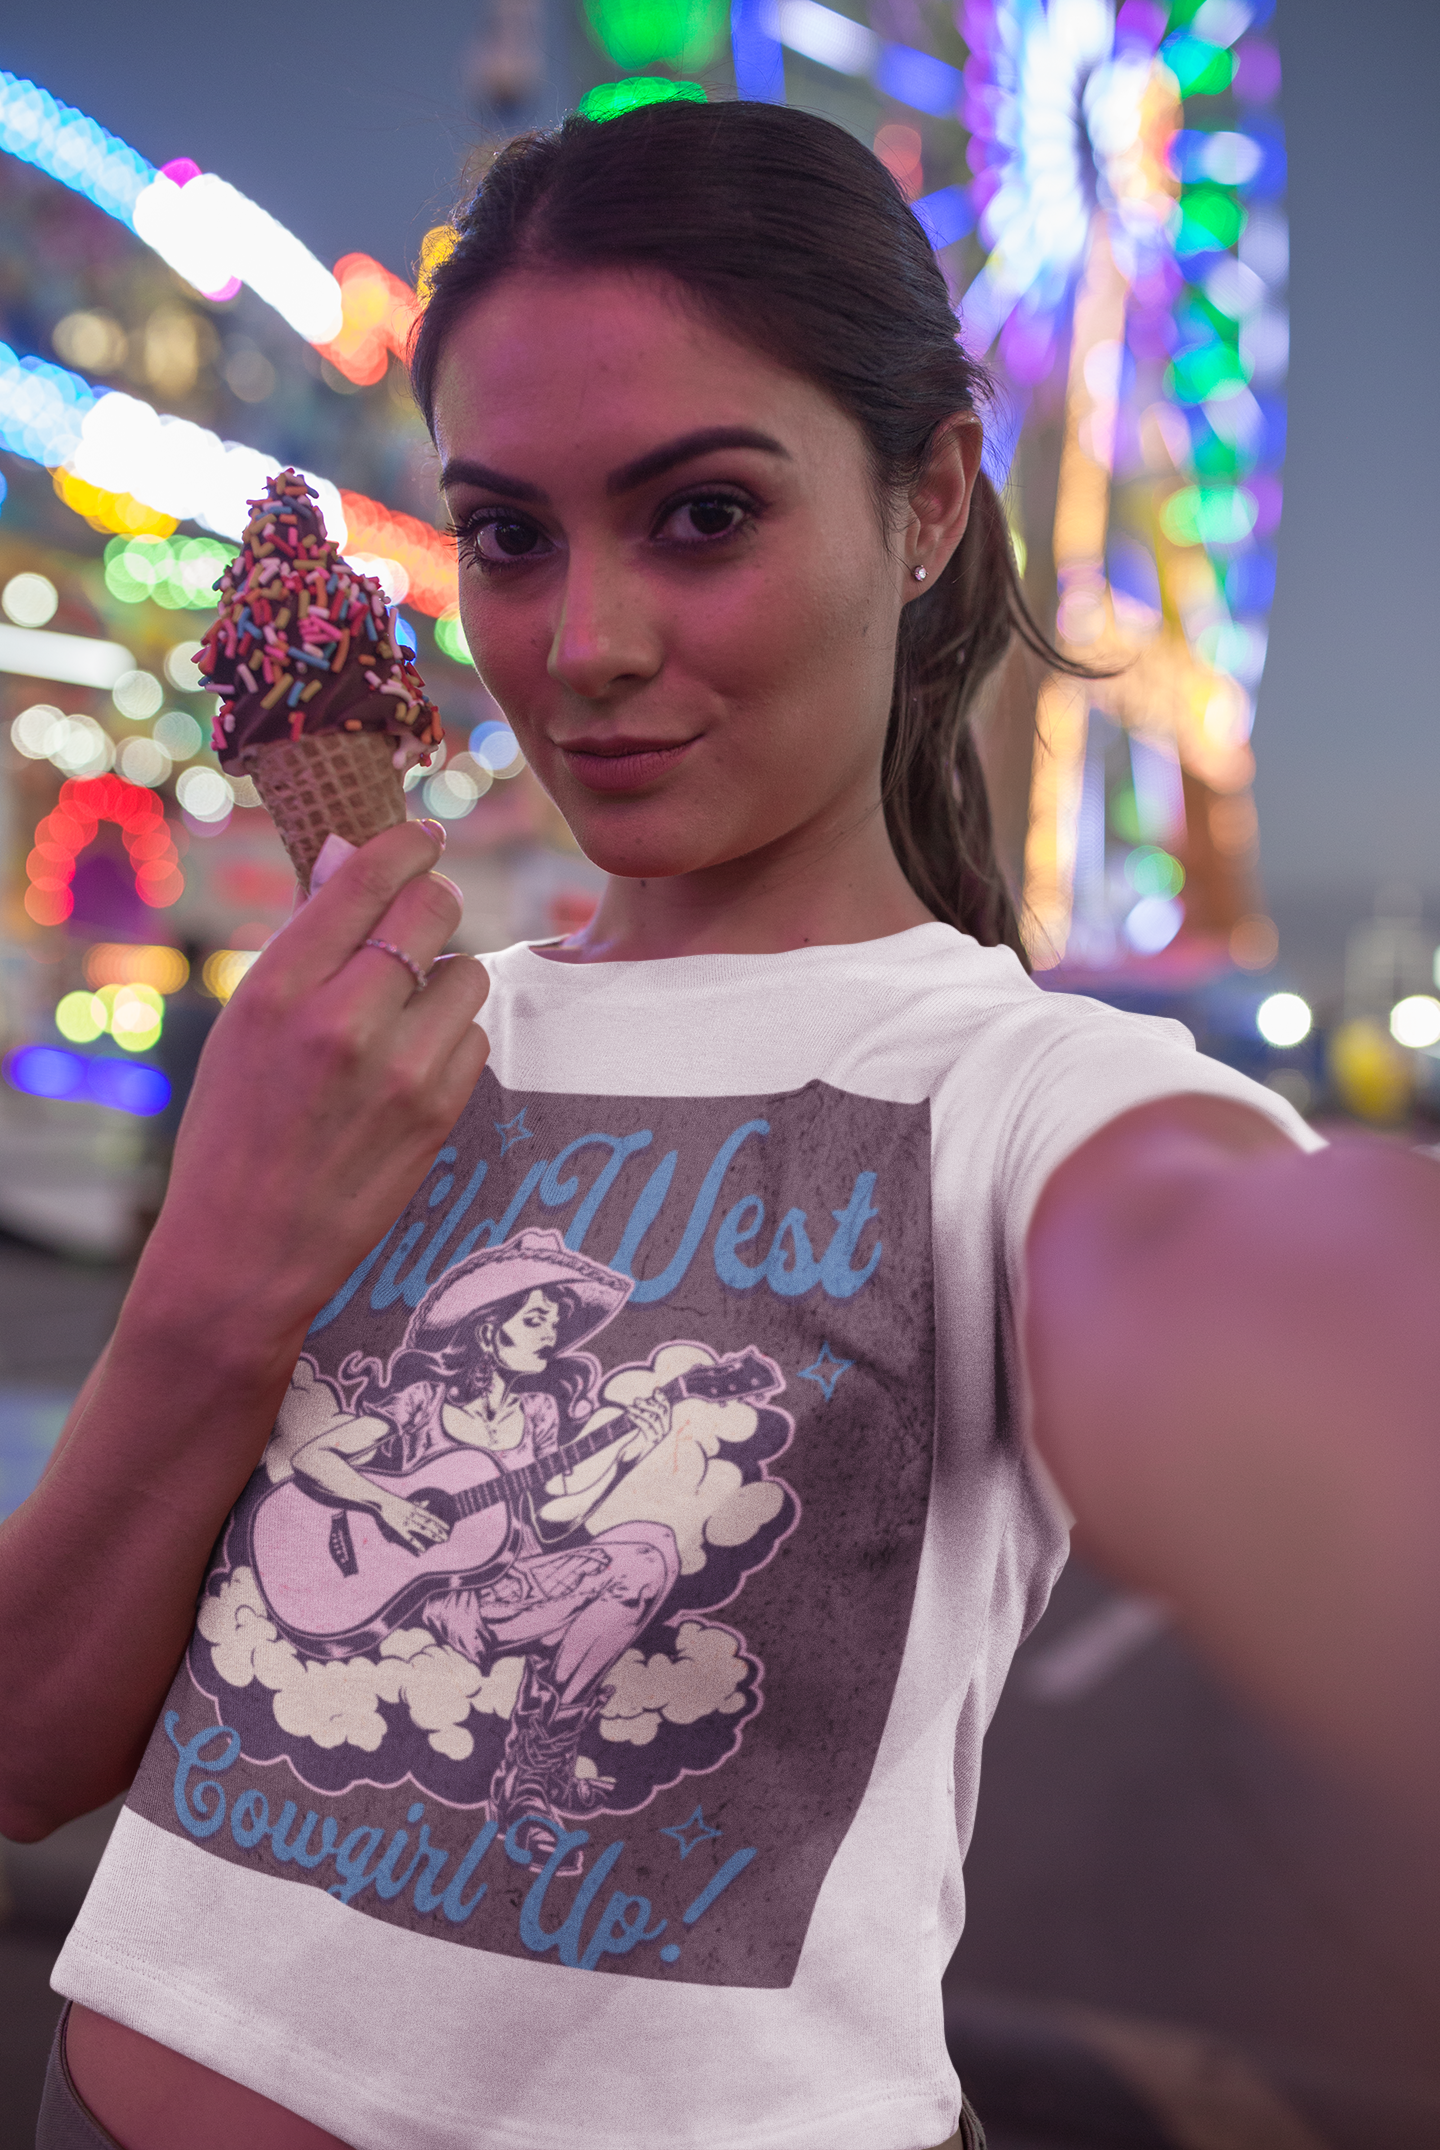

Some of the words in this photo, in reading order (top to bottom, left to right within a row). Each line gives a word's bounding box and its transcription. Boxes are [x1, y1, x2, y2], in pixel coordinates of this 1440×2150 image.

[538, 1118, 883, 1302] West
[164, 1710, 501, 1924] Cowgirl
[504, 1813, 759, 1970] Up!
